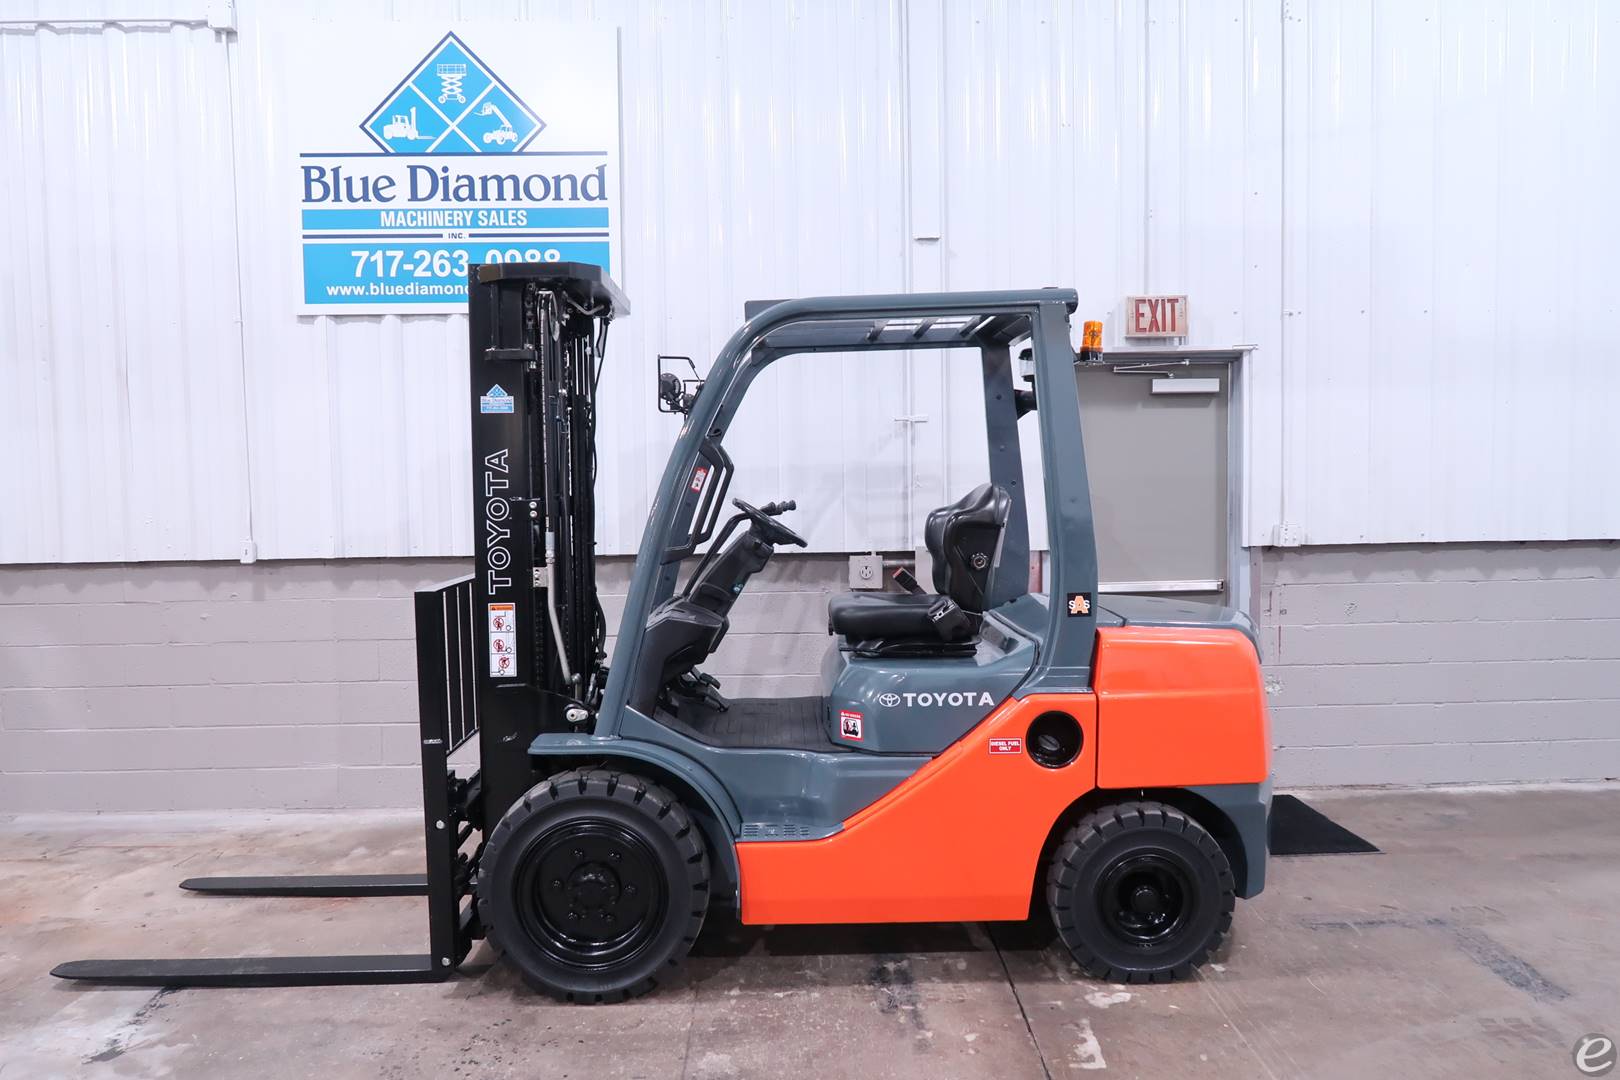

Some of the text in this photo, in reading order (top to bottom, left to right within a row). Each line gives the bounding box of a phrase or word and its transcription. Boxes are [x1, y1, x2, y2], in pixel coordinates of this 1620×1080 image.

[301, 163, 608, 203] Blue Diamond
[380, 209, 528, 227] MACHINERY SALES
[1135, 298, 1179, 332] EXIT
[485, 449, 512, 595] TOYOTA
[1068, 595, 1090, 614] SAS
[903, 692, 995, 707] TOYOTA
